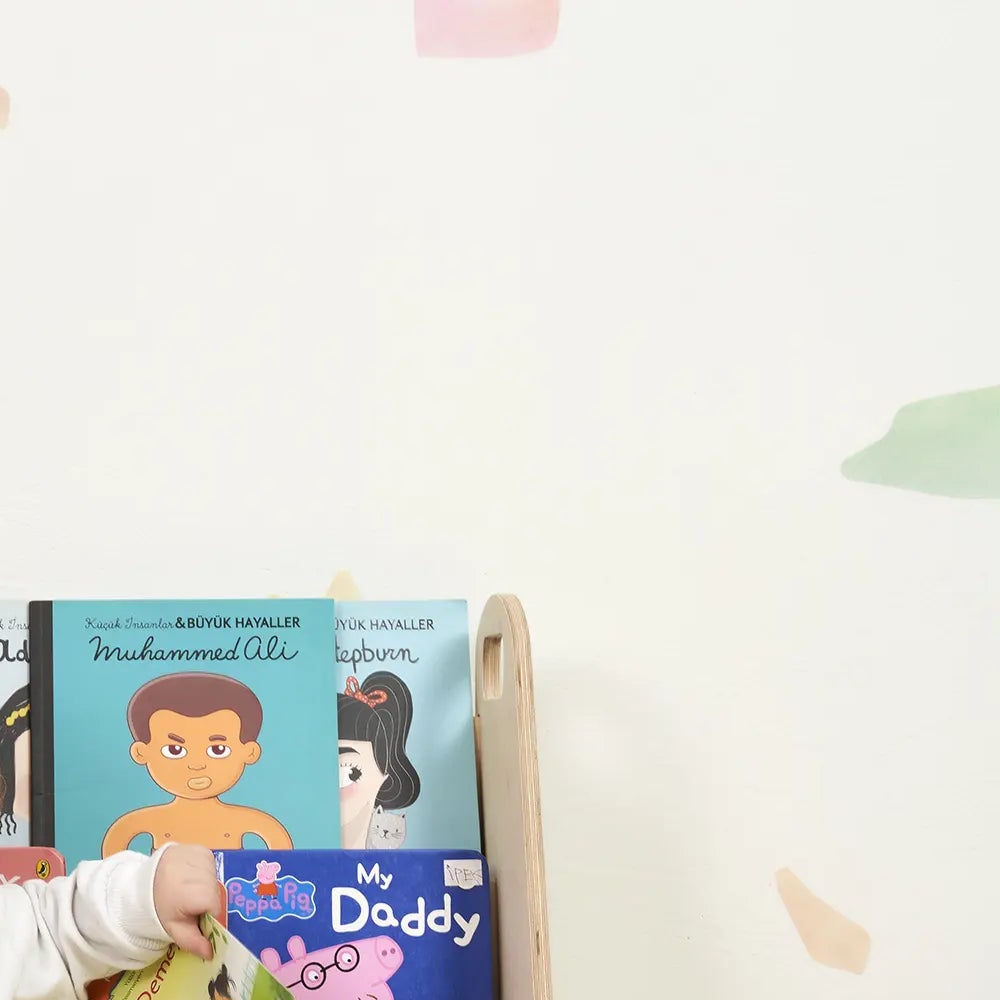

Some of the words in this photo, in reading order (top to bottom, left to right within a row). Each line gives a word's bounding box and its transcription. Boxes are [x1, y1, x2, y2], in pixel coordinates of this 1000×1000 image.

[235, 616, 300, 629] HAYALLER
[370, 618, 435, 630] HAYALLER
[89, 635, 241, 661] Muhammed
[244, 635, 299, 660] Ali
[357, 862, 393, 890] My
[229, 882, 282, 917] Peppa
[284, 881, 313, 914] Pig
[331, 887, 480, 947] Daddy
